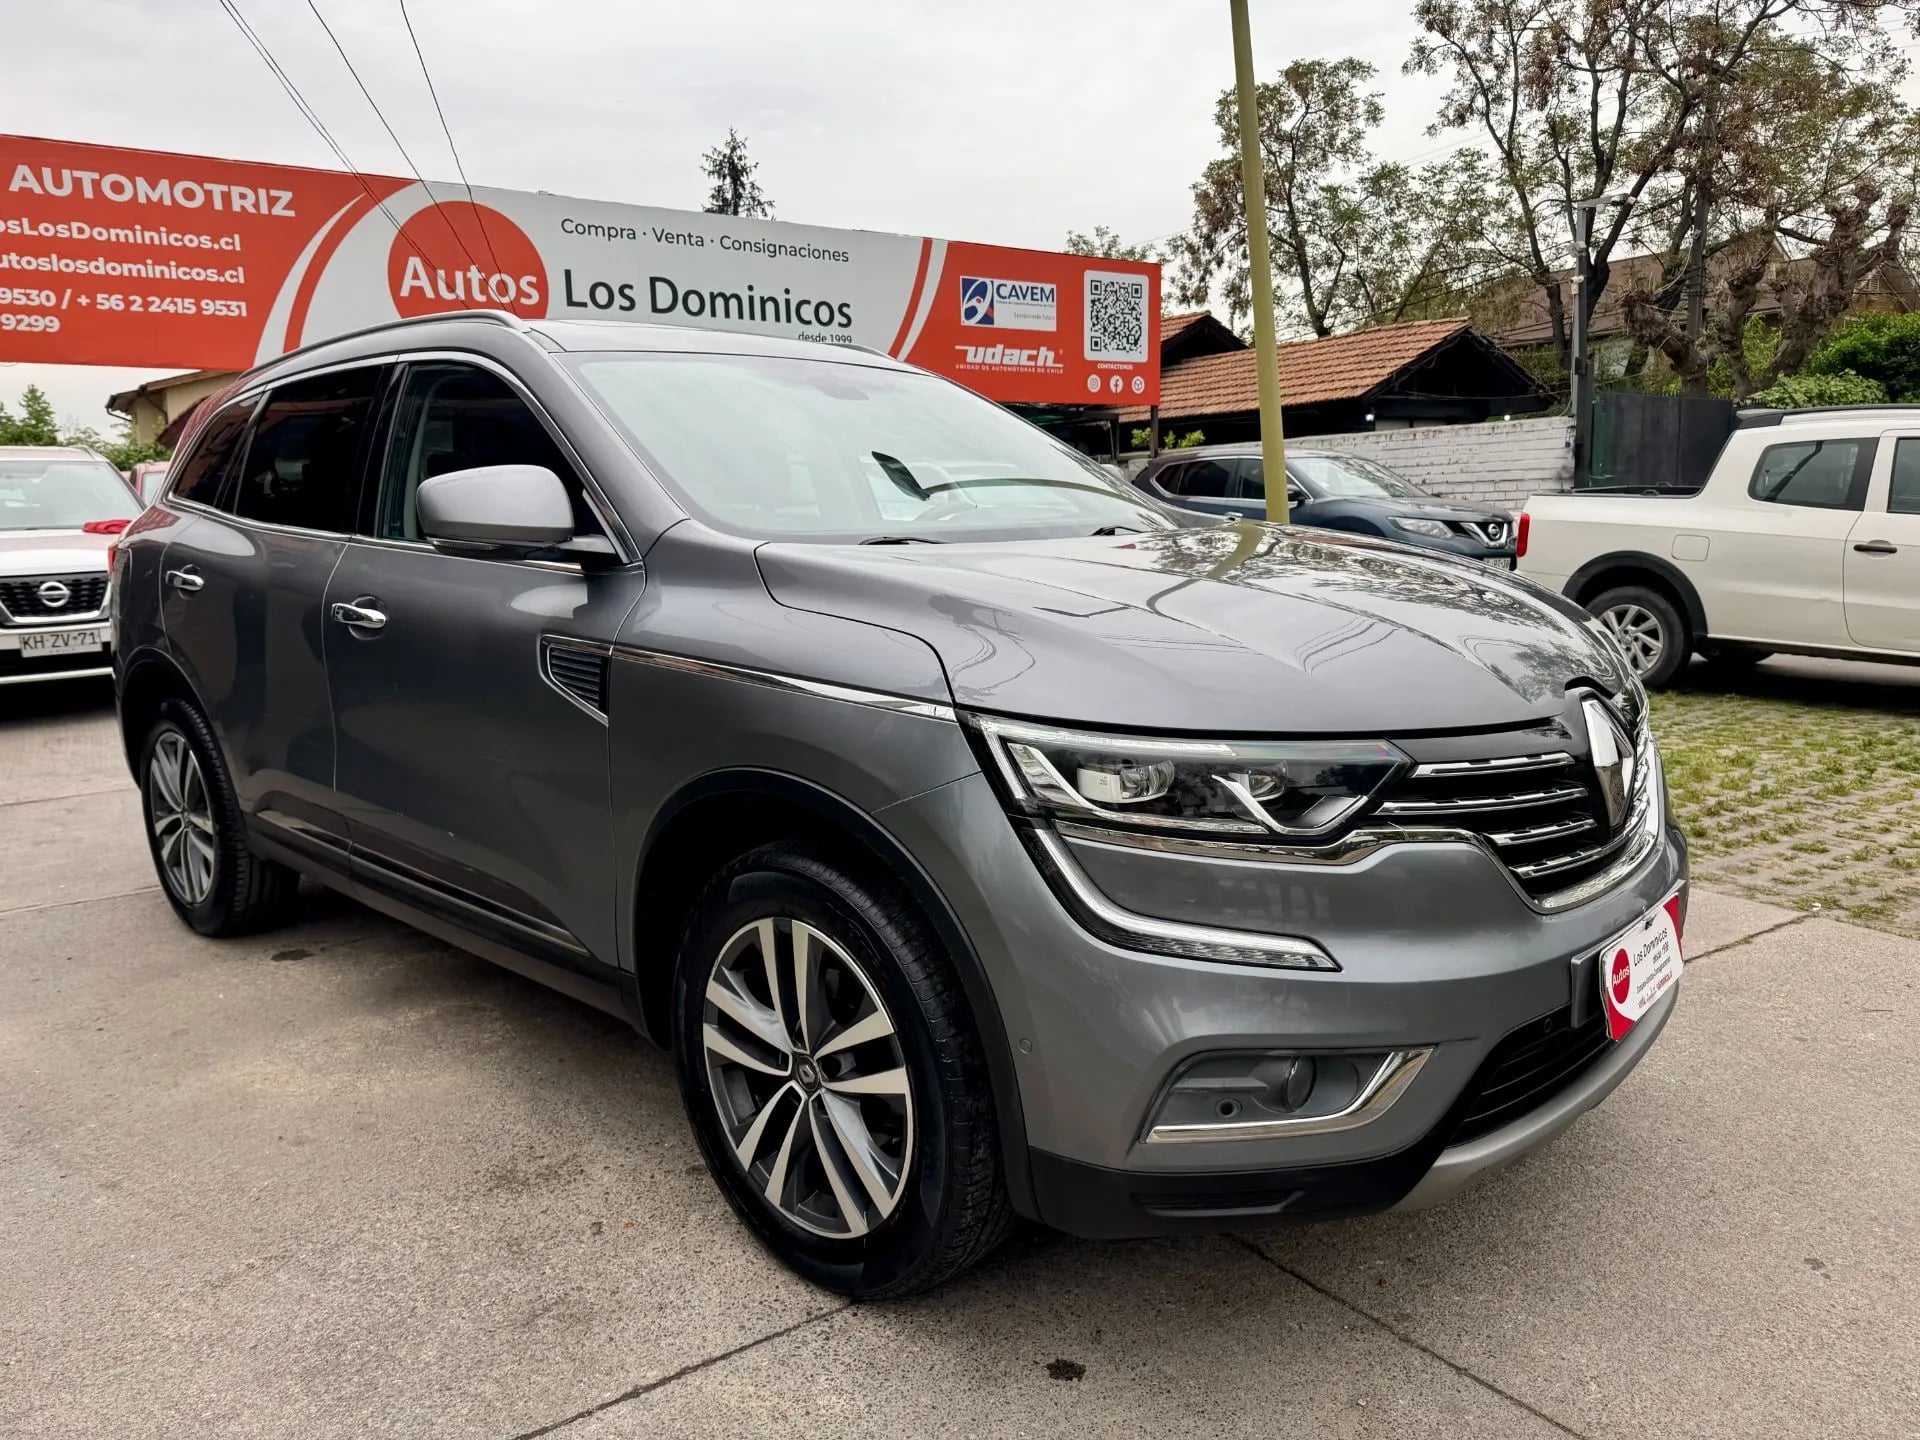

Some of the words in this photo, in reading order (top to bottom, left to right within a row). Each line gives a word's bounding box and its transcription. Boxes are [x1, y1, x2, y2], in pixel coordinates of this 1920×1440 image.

[9, 164, 296, 217] AUTOMOTRIZ
[561, 218, 636, 242] Compra
[652, 227, 705, 247] Venta
[720, 235, 849, 262] Consignaciones
[400, 257, 540, 305] Autos
[0, 287, 56, 307] 9530
[96, 293, 125, 311] 56
[129, 295, 144, 312] 2
[147, 296, 197, 315] 2415
[201, 299, 247, 317] 9531
[564, 269, 636, 311] Los
[649, 276, 852, 328] Dominicos
[996, 283, 1055, 303] CAVEM
[0, 313, 60, 333] 9299
[798, 331, 827, 342] desde
[830, 334, 852, 343] 1999
[955, 344, 1064, 367] udach
[1633, 950, 1643, 966] Los
[1612, 966, 1630, 988] Autos
